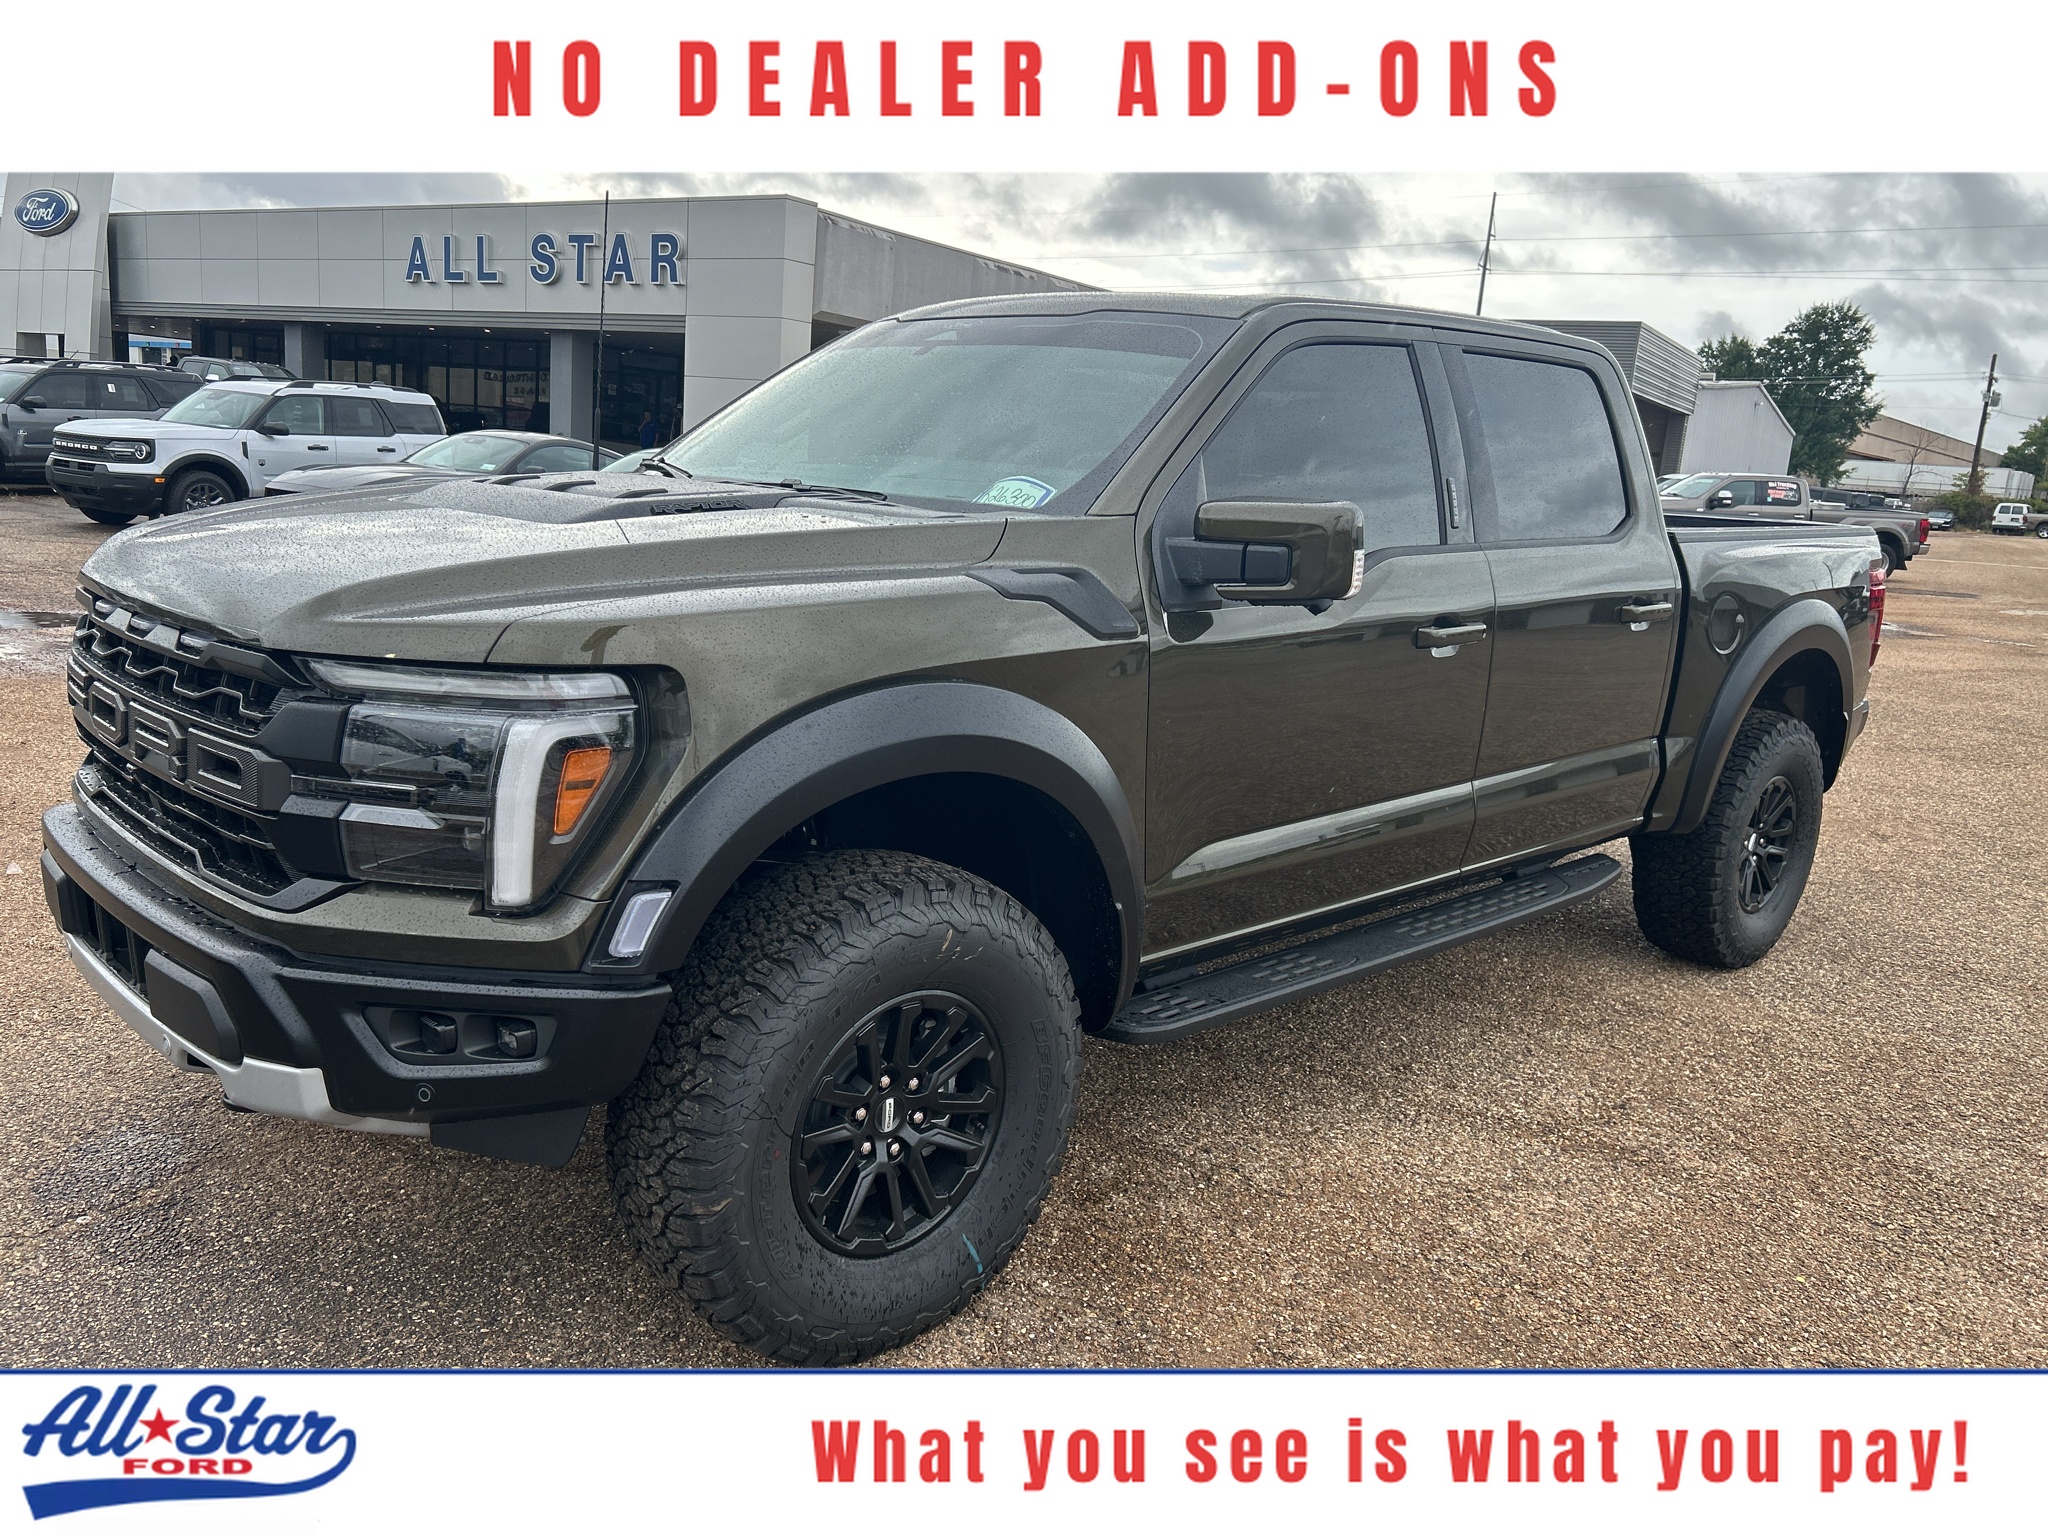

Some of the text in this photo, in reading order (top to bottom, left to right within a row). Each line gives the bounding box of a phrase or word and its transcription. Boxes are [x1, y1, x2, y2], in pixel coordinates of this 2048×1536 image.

[23, 197, 56, 222] Ford
[405, 232, 684, 284] ALL STAR
[55, 440, 98, 450] BRONCO
[651, 500, 749, 515] RAPTOR
[67, 656, 272, 810] FORD
